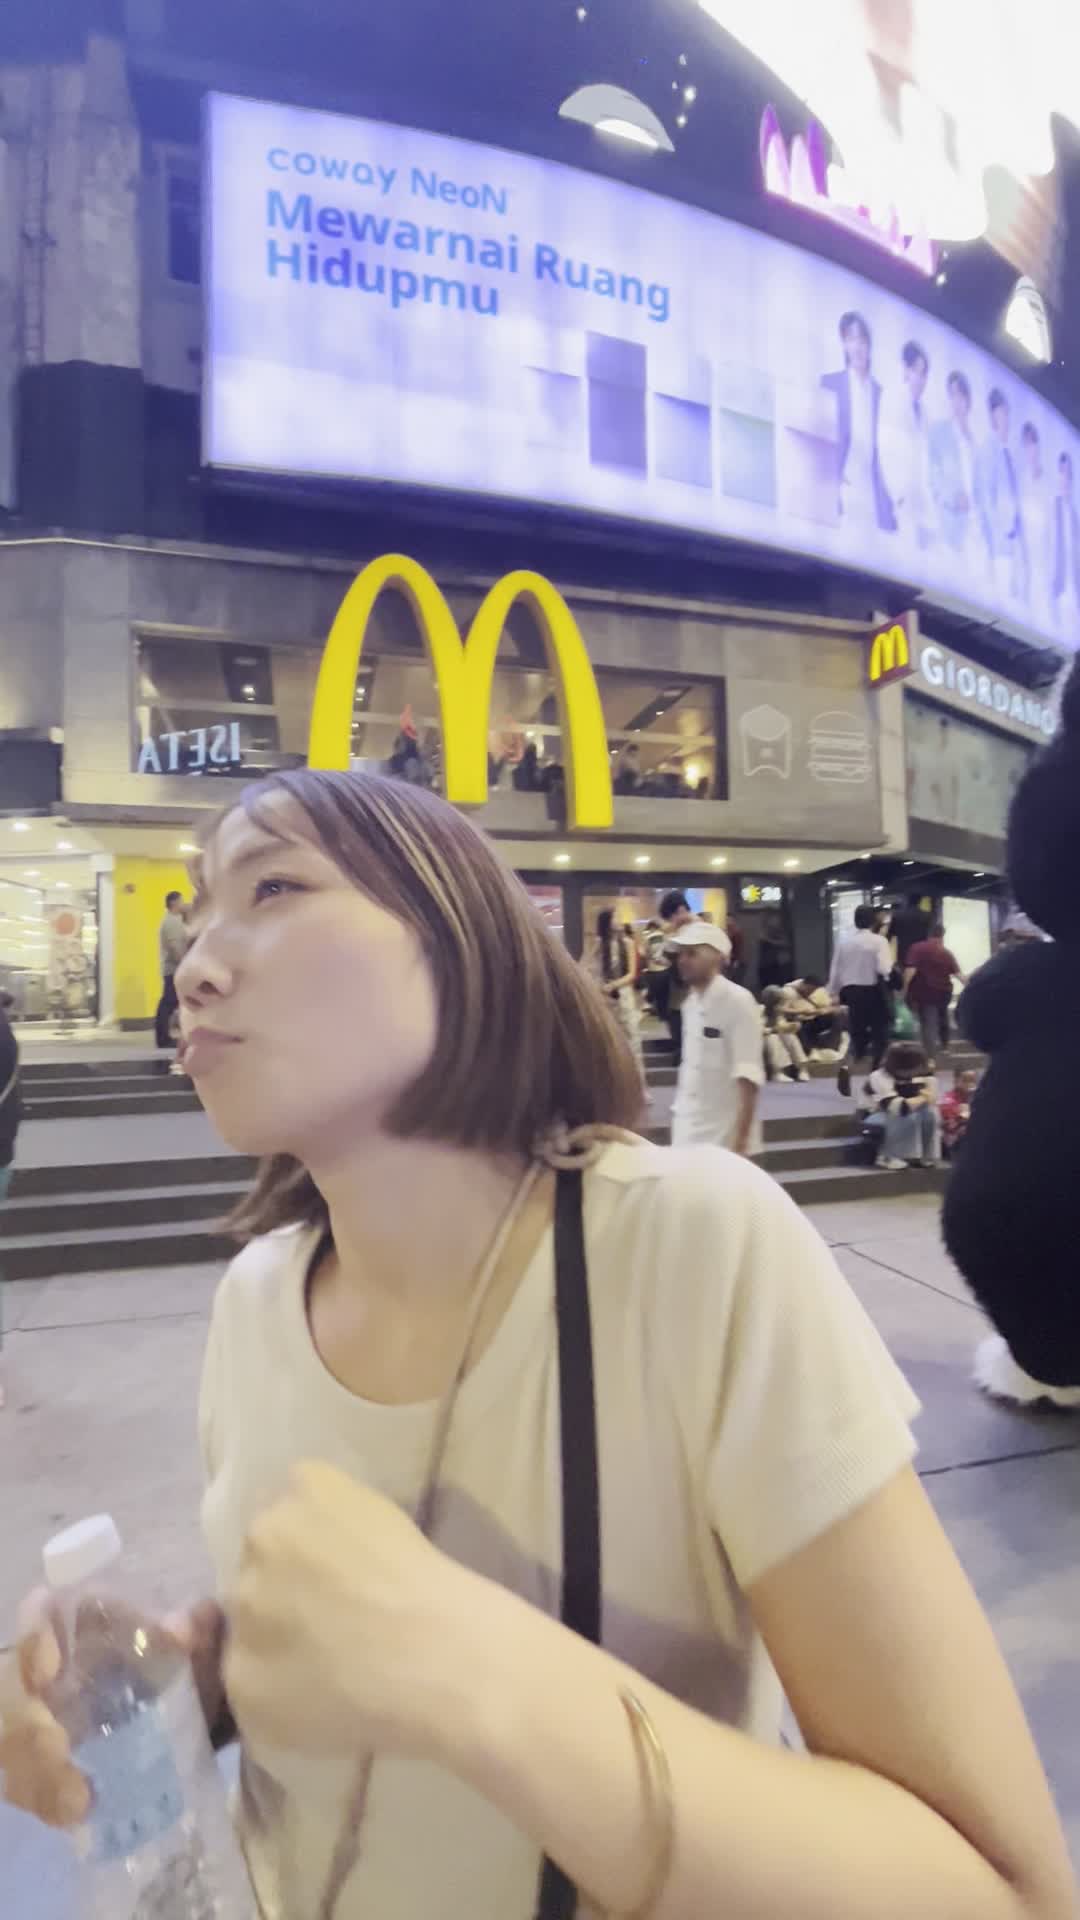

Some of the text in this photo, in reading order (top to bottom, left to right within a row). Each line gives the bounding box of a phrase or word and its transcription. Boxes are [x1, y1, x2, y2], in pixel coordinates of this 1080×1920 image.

[267, 148, 507, 215] coway NeoN
[267, 190, 670, 322] Mewarnai Ruang
[267, 240, 499, 316] Hidupmu
[920, 646, 1058, 735] GIORDANO
